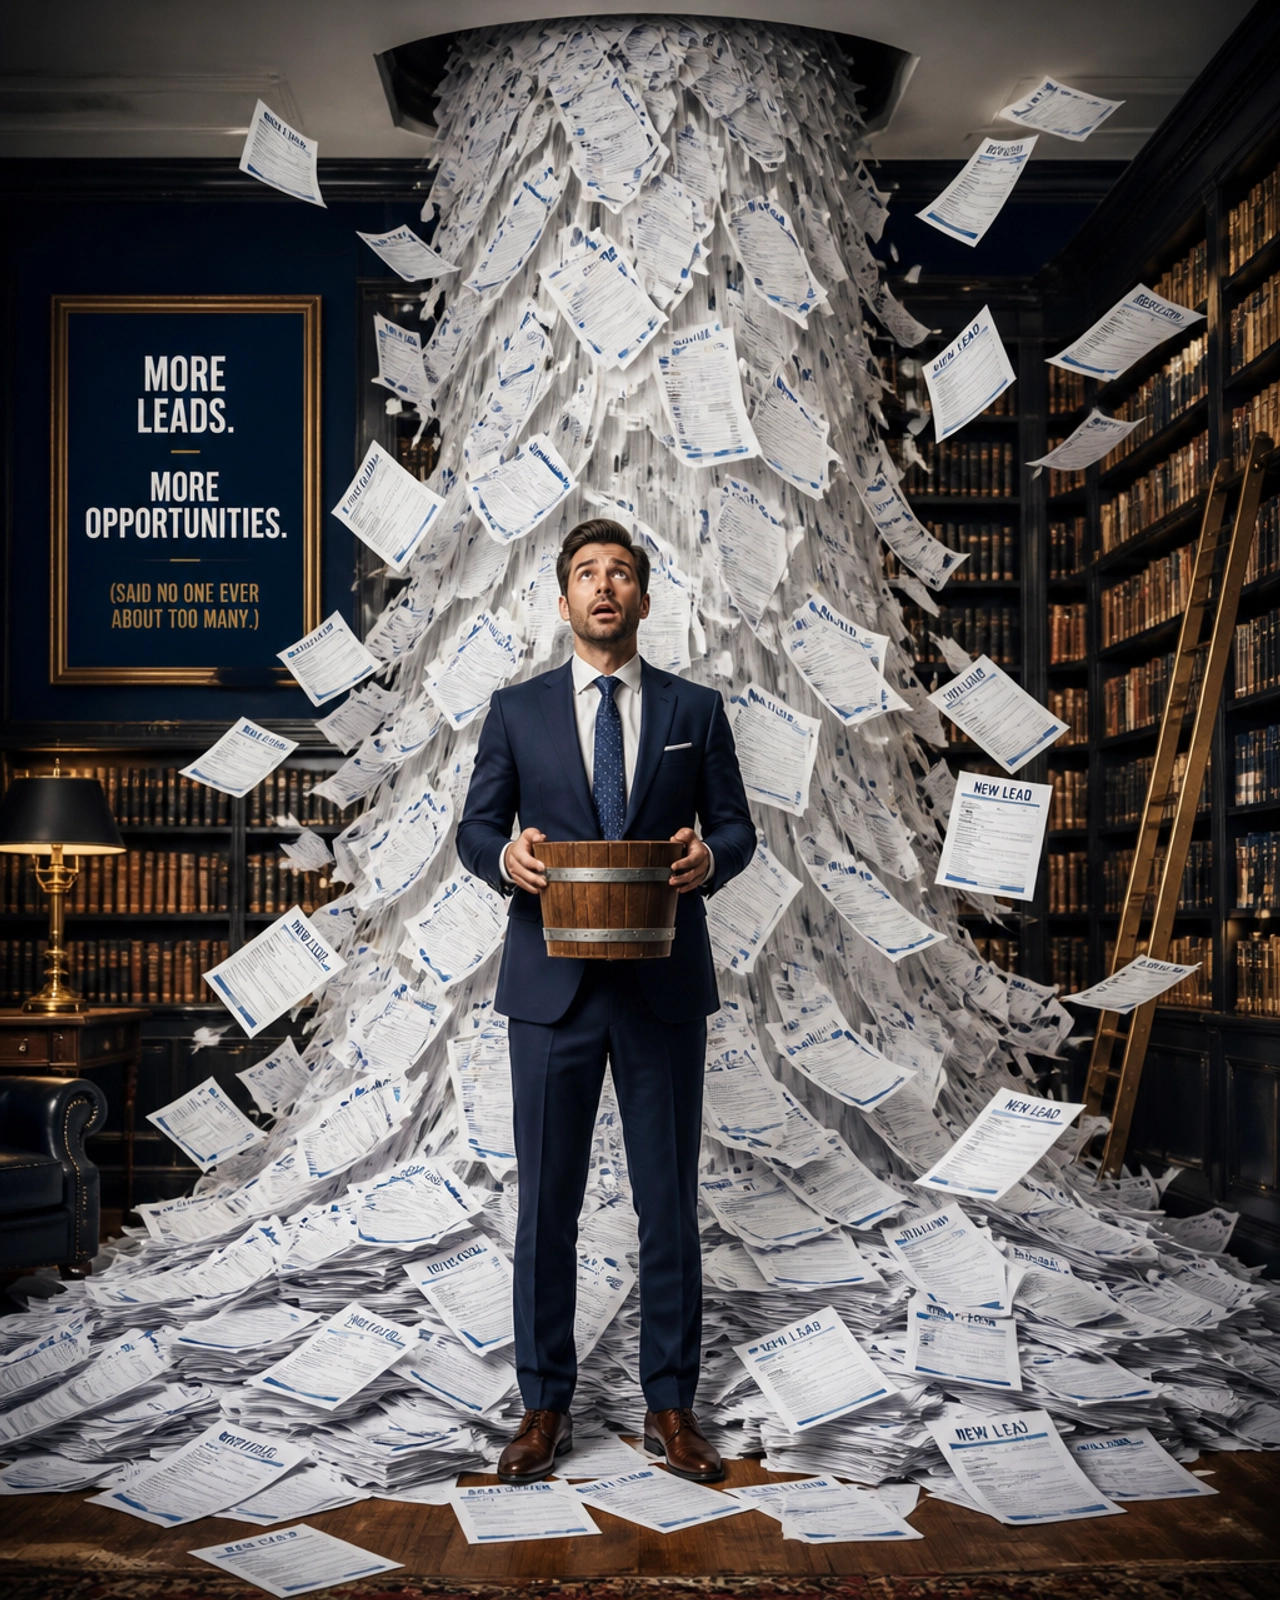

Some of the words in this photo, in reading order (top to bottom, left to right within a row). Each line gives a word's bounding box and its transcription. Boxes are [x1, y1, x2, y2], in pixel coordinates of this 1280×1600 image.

[144, 355, 226, 392] MORE
[138, 398, 235, 433] LEADS.
[150, 471, 220, 502] MORE
[85, 507, 288, 539] OPPORTUNITIES.
[110, 583, 152, 604] (SAID
[157, 583, 178, 603] NO
[183, 583, 214, 603] ONE
[219, 583, 259, 603] EVER
[111, 608, 164, 629] ABOUT
[167, 608, 198, 629] TOO
[203, 608, 259, 631] MANY.)
[973, 781, 1000, 797] NEW
[1002, 786, 1032, 802] LEAD
[1029, 1105, 1061, 1119] LEAD
